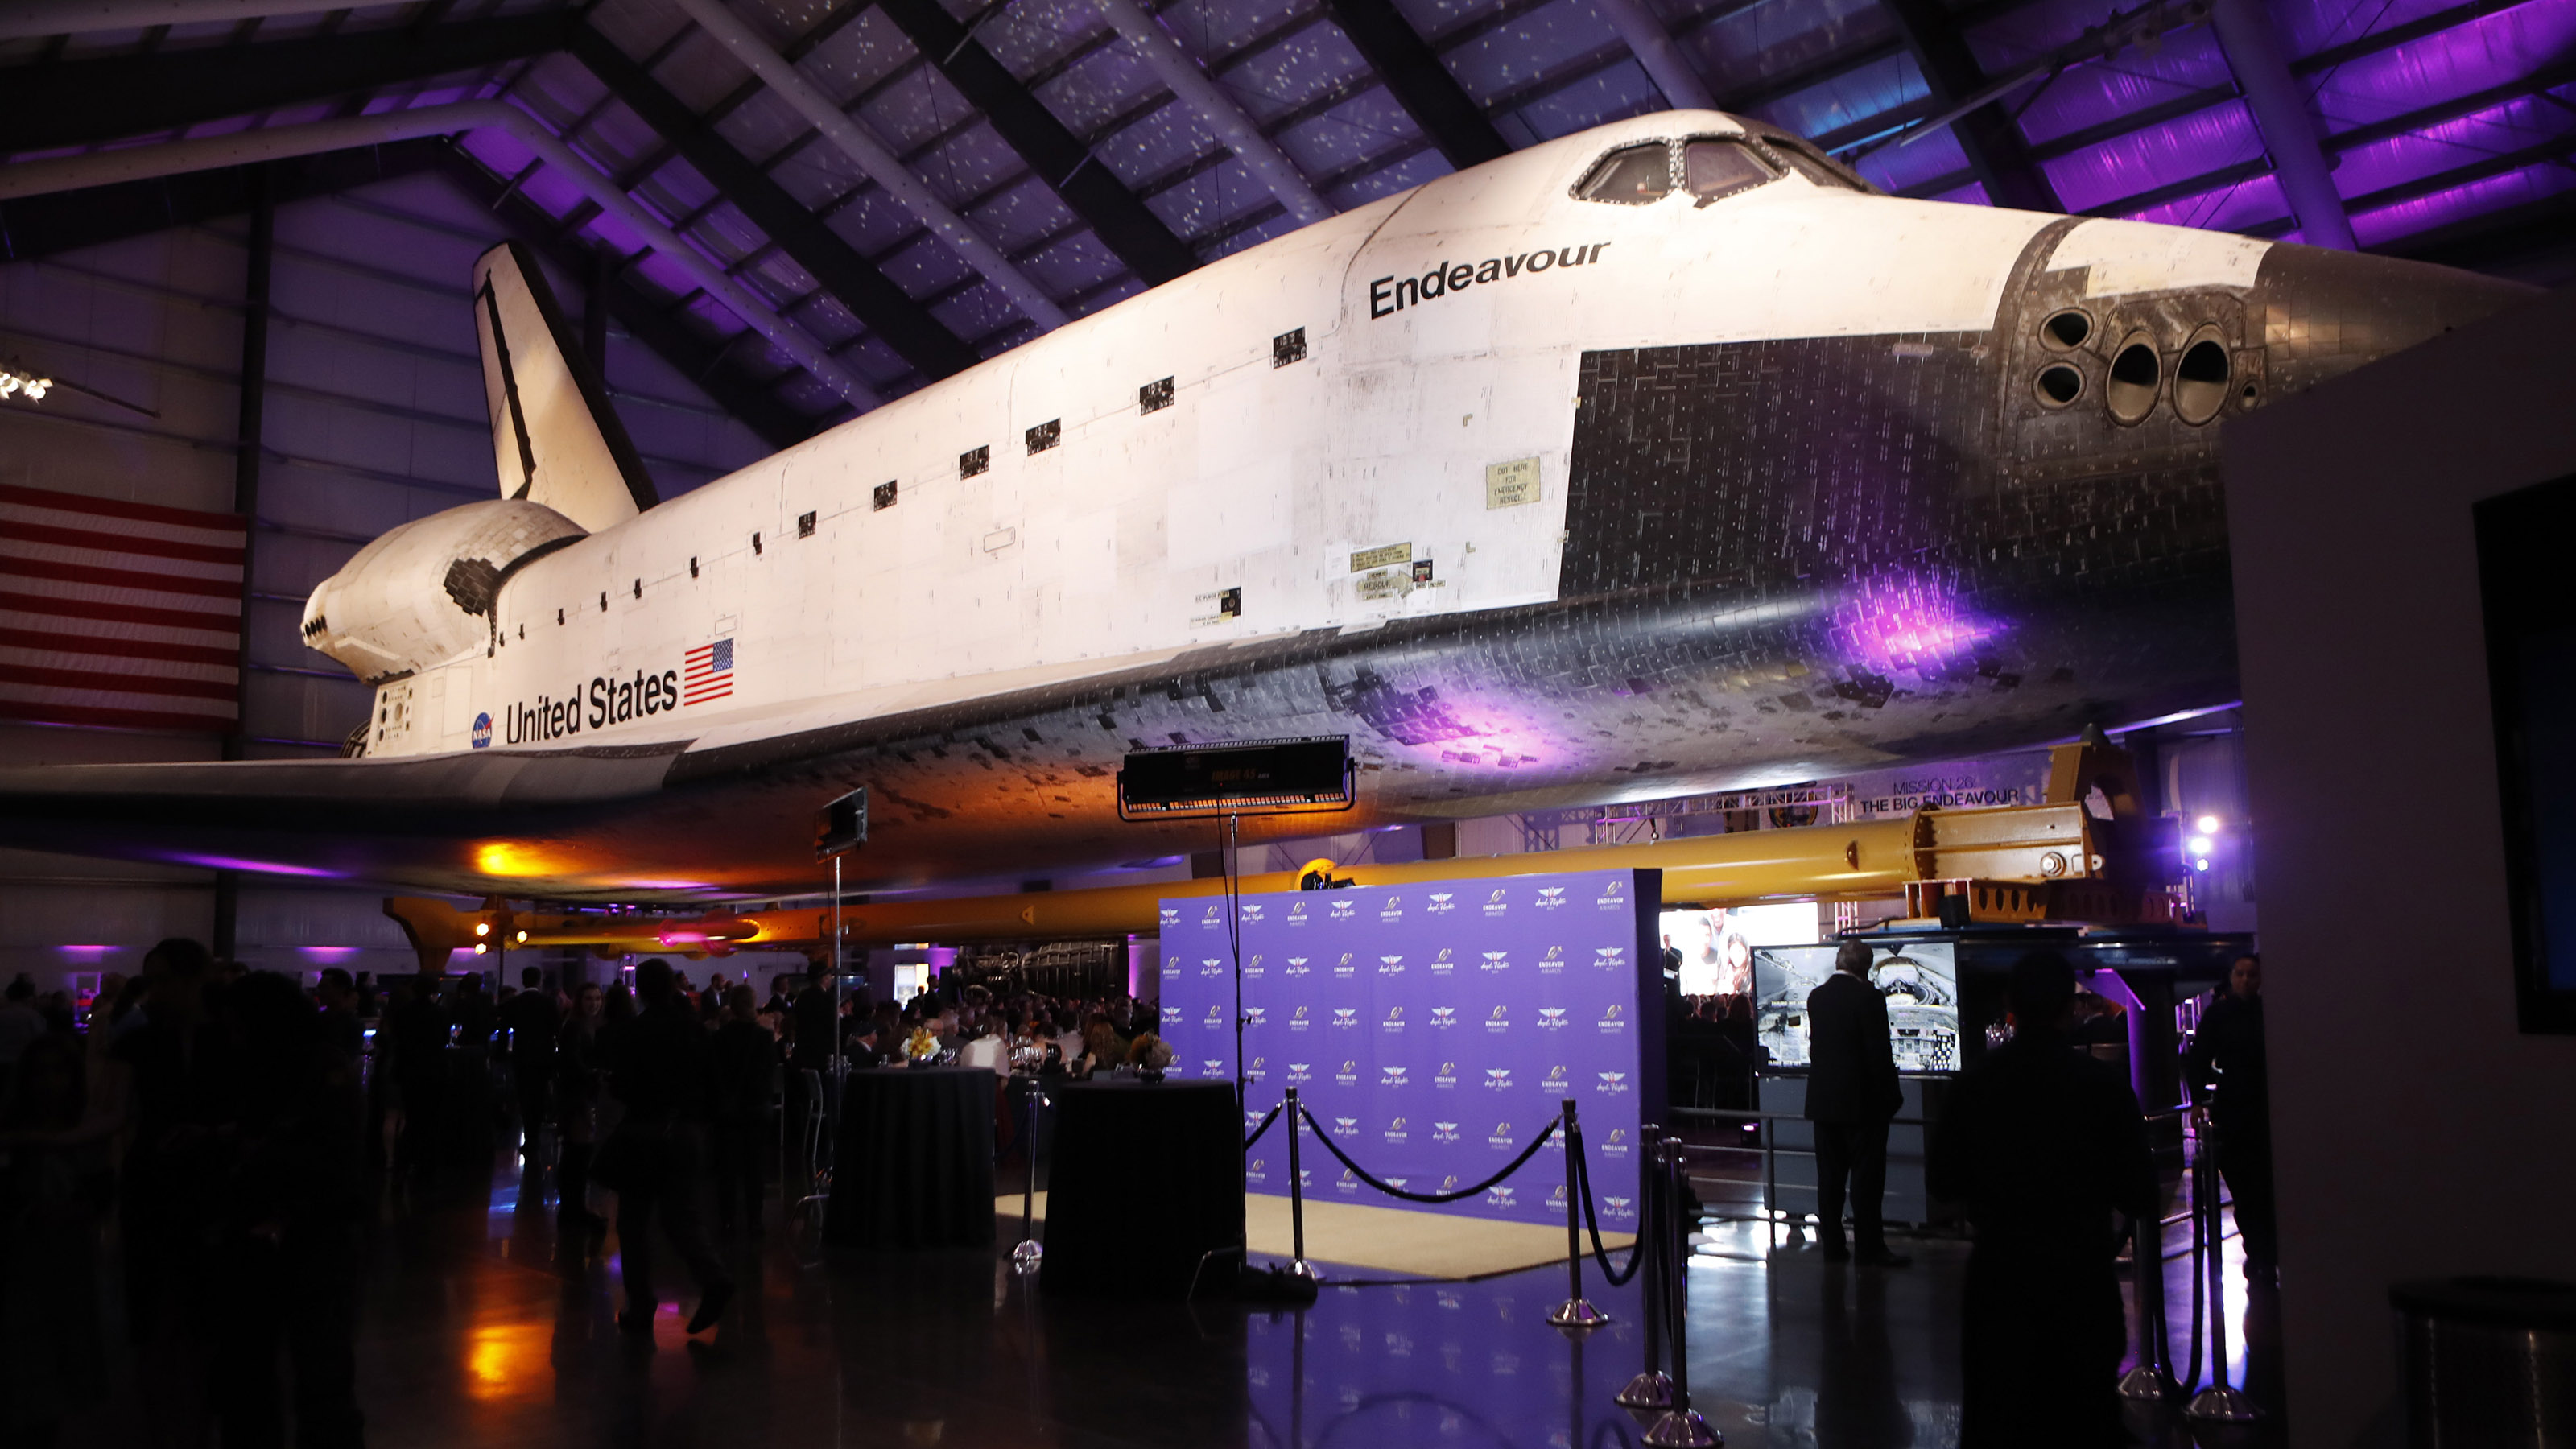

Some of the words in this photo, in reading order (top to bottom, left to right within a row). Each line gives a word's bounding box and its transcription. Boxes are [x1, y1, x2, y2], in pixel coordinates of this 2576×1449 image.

[1370, 242, 1612, 320] Endeavour
[506, 684, 581, 744] United
[589, 670, 678, 729] States
[473, 726, 493, 740] NASA
[1893, 778, 1952, 795] MISSION
[1860, 799, 1889, 813] THE
[1893, 797, 1918, 811] BIG
[1923, 788, 2019, 807] ENDEAVOUR
[1385, 1131, 1407, 1139] ENDEAVOR
[1489, 1137, 1513, 1145] ENDEAVOR
[1601, 1144, 1628, 1153] ENDEAVOR
